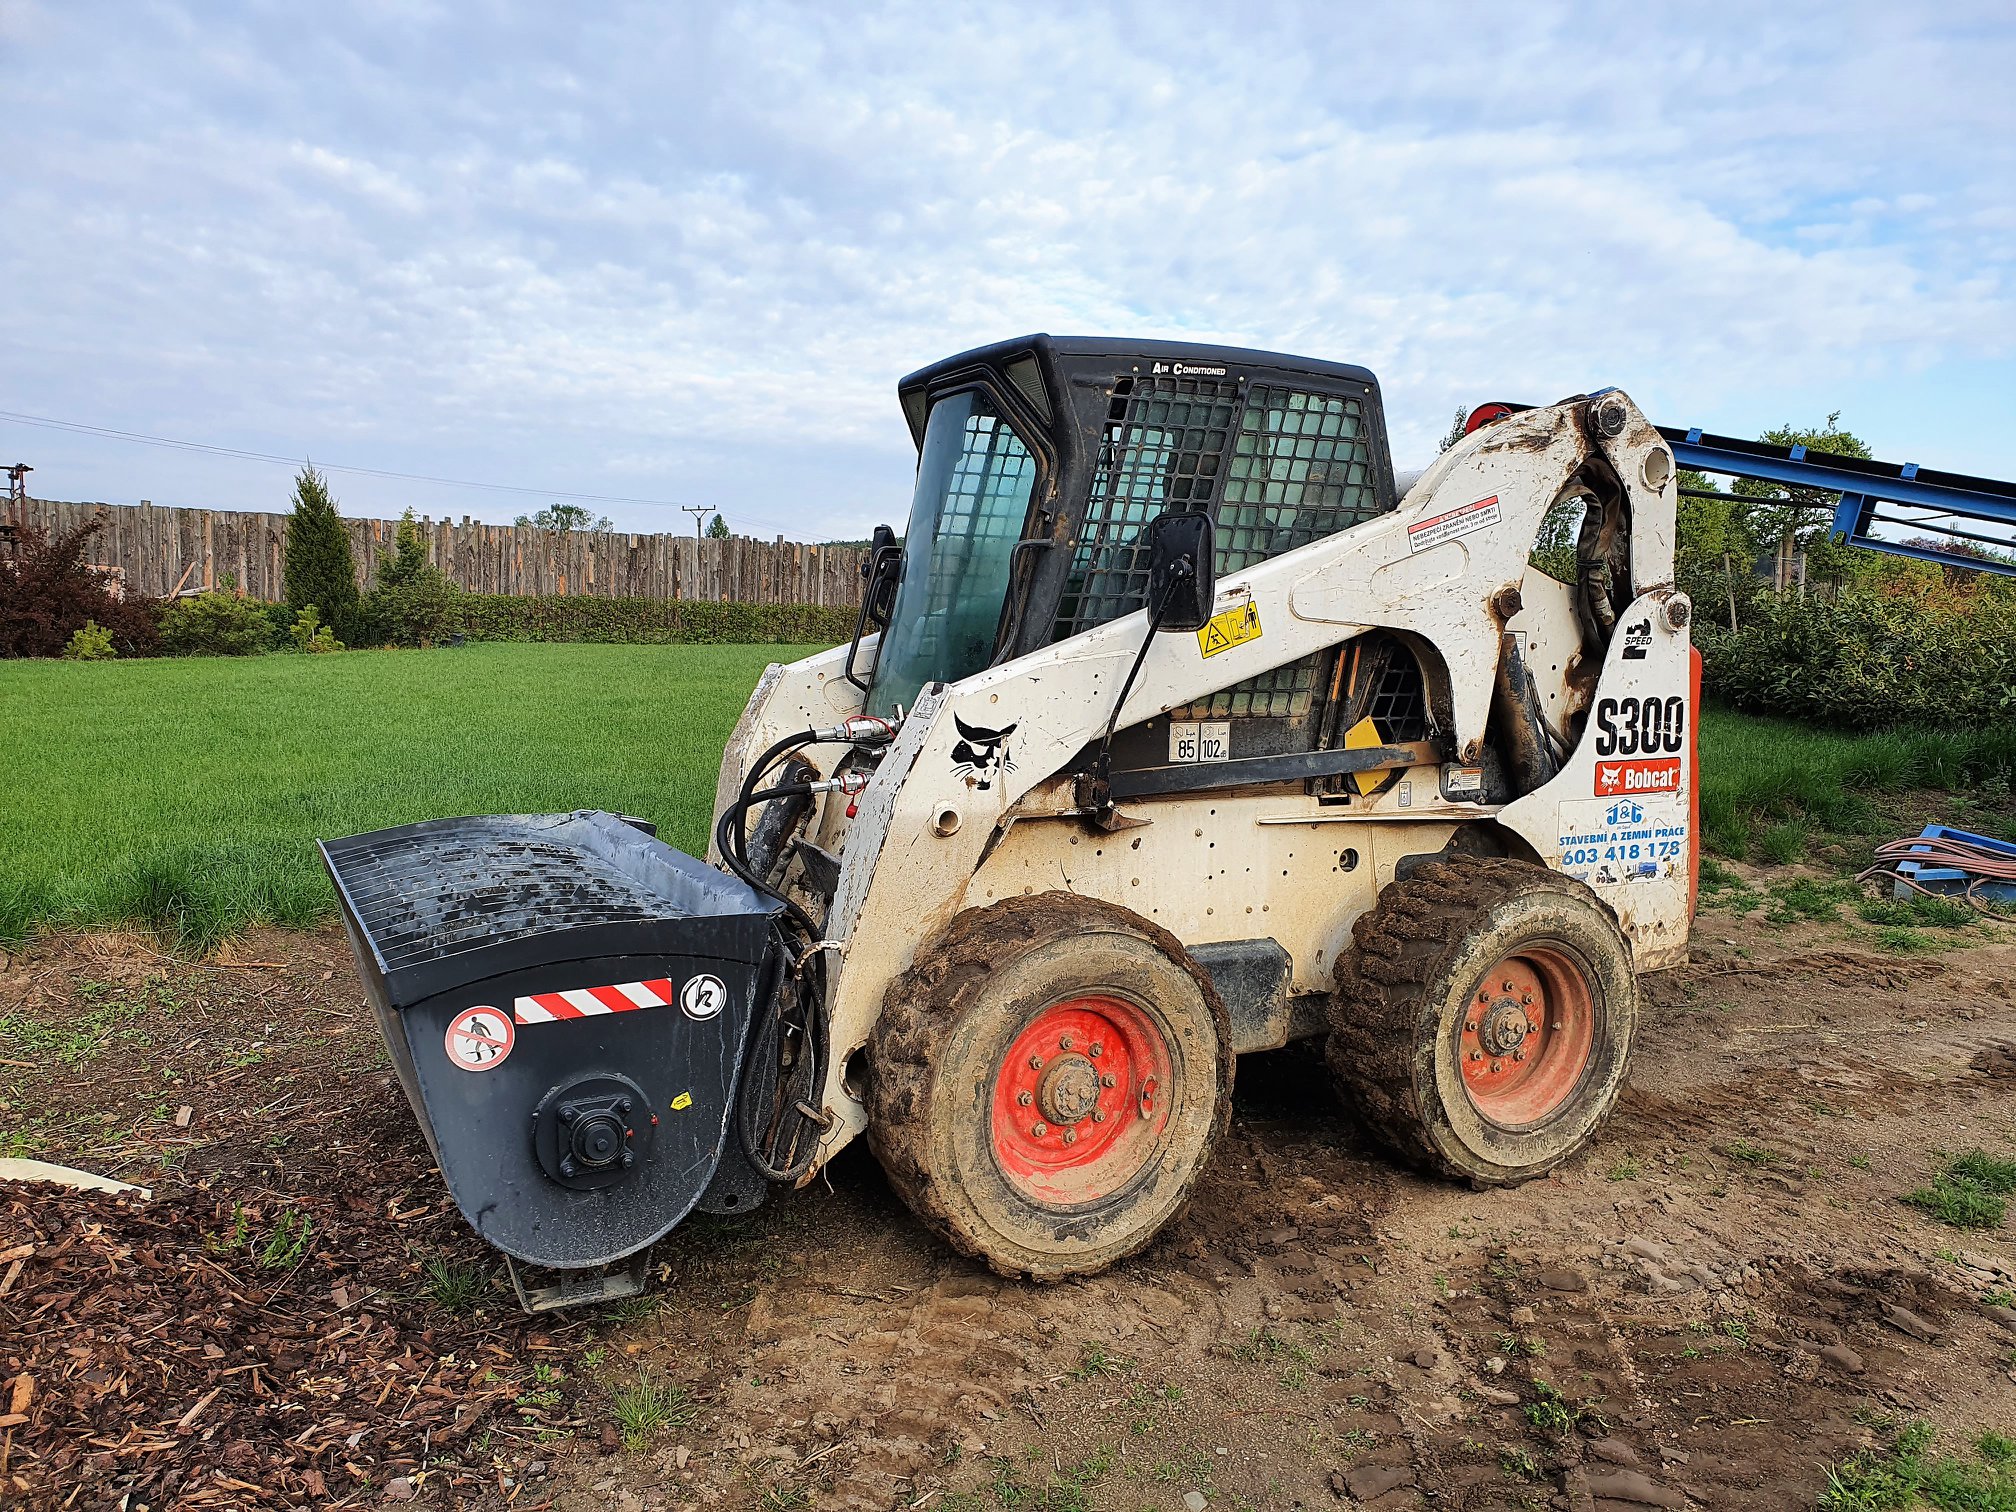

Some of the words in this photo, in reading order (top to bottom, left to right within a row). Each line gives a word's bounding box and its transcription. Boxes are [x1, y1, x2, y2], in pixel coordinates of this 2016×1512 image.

[1465, 513, 1479, 522] NEBO
[1624, 636, 1653, 645] SPEED
[1596, 696, 1684, 756] S300
[1178, 740, 1194, 758] 85
[1201, 739, 1221, 758] 102
[1625, 767, 1673, 789] Bobcat
[1559, 831, 1608, 846] STAVEBNÍ
[1610, 832, 1618, 842] A
[1621, 828, 1651, 841] ZEMNÍ
[1655, 825, 1685, 838] PRÁCE
[1562, 848, 1598, 866] 603
[1604, 844, 1640, 862] 418
[1647, 840, 1681, 858] 178
